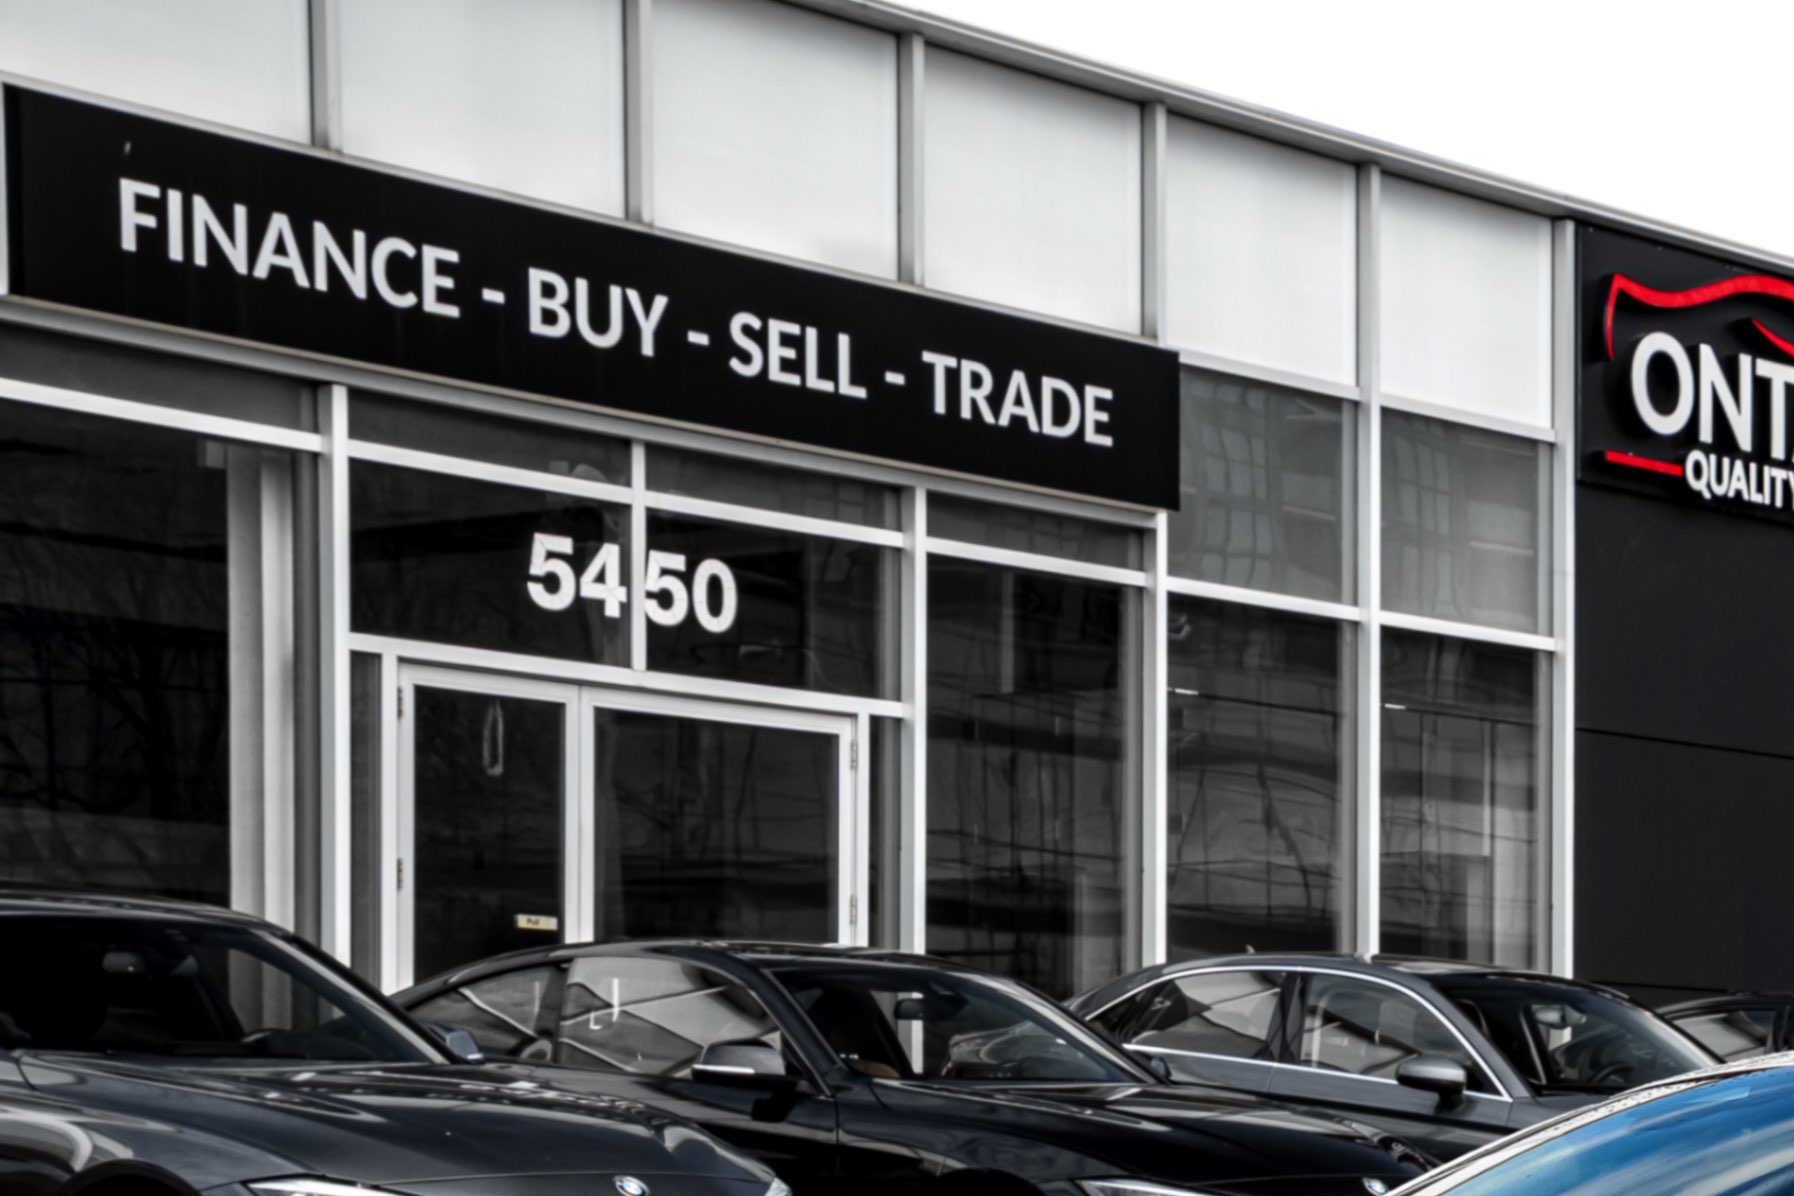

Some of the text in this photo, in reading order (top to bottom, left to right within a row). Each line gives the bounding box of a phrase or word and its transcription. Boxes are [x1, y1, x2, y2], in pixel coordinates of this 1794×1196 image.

[118, 177, 461, 319] FINANCE
[528, 267, 669, 357] BUY
[729, 311, 867, 399] SELL
[921, 350, 1113, 447] TRADE
